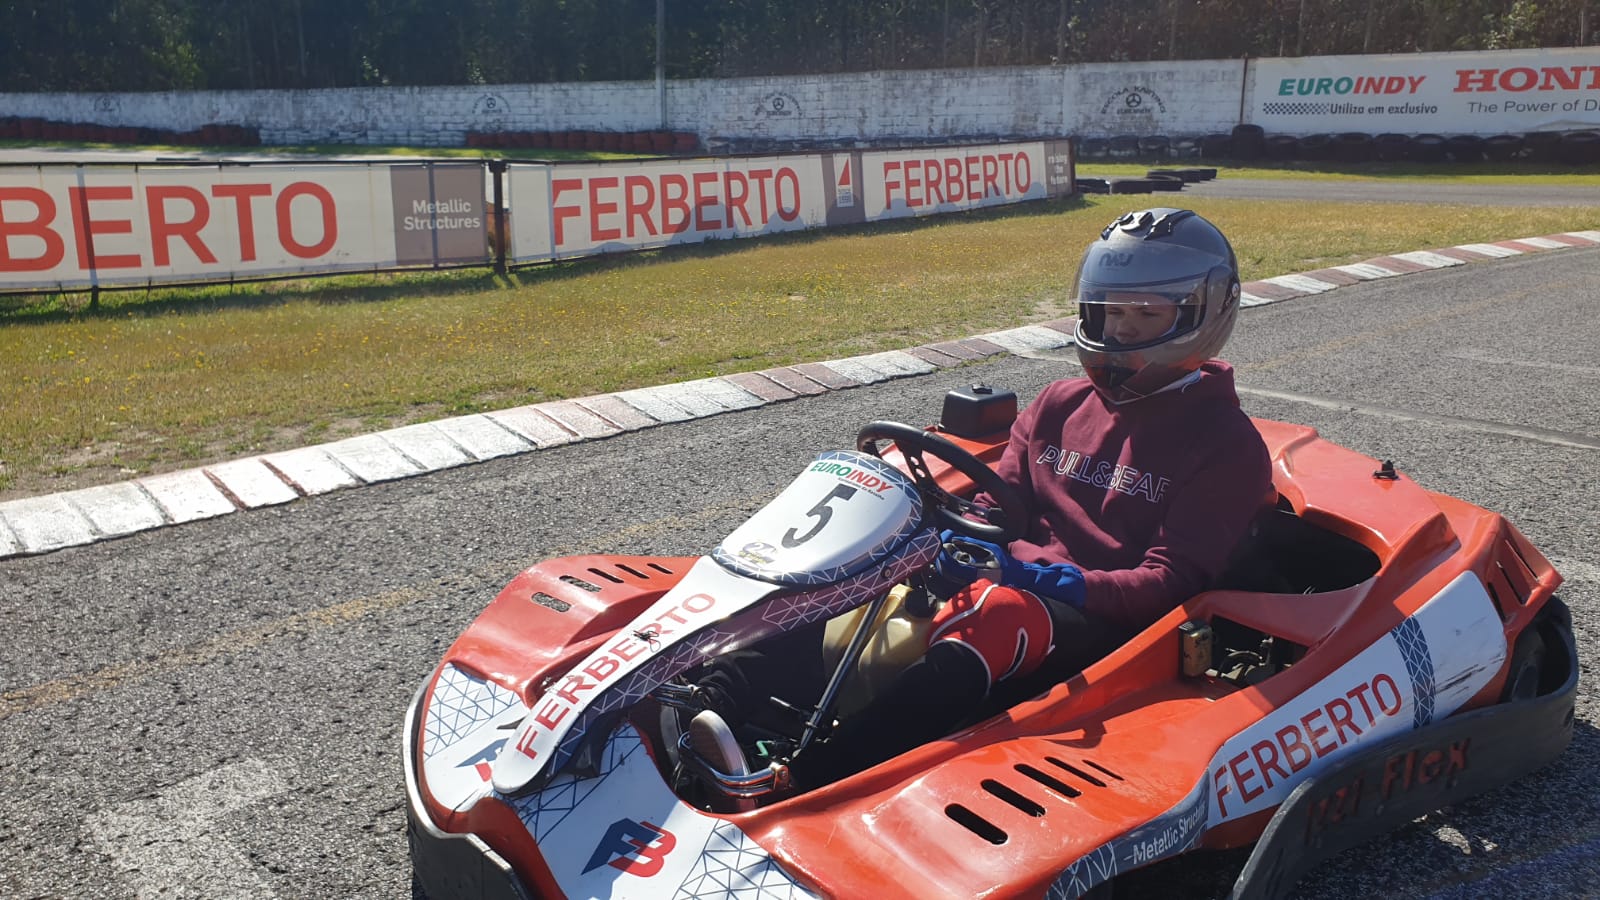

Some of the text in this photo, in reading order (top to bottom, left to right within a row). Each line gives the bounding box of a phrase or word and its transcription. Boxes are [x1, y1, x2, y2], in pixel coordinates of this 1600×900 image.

[1278, 75, 1426, 96] EUROINDY
[1453, 66, 1600, 93] HON
[1329, 102, 1438, 115] Utiliza em exclusivo
[1468, 99, 1600, 113] The Power of D
[883, 151, 1031, 210] FERBERTO
[413, 199, 471, 214] Metallic
[551, 166, 800, 245] FERBERTO
[0, 181, 338, 272] BERTO
[404, 216, 480, 231] Structures
[810, 461, 894, 492] EUROINDY
[781, 483, 858, 548] 5
[515, 592, 716, 760] FERBERTO
[1214, 673, 1402, 818] FERBERTO
[1133, 826, 1179, 865] Metallic
